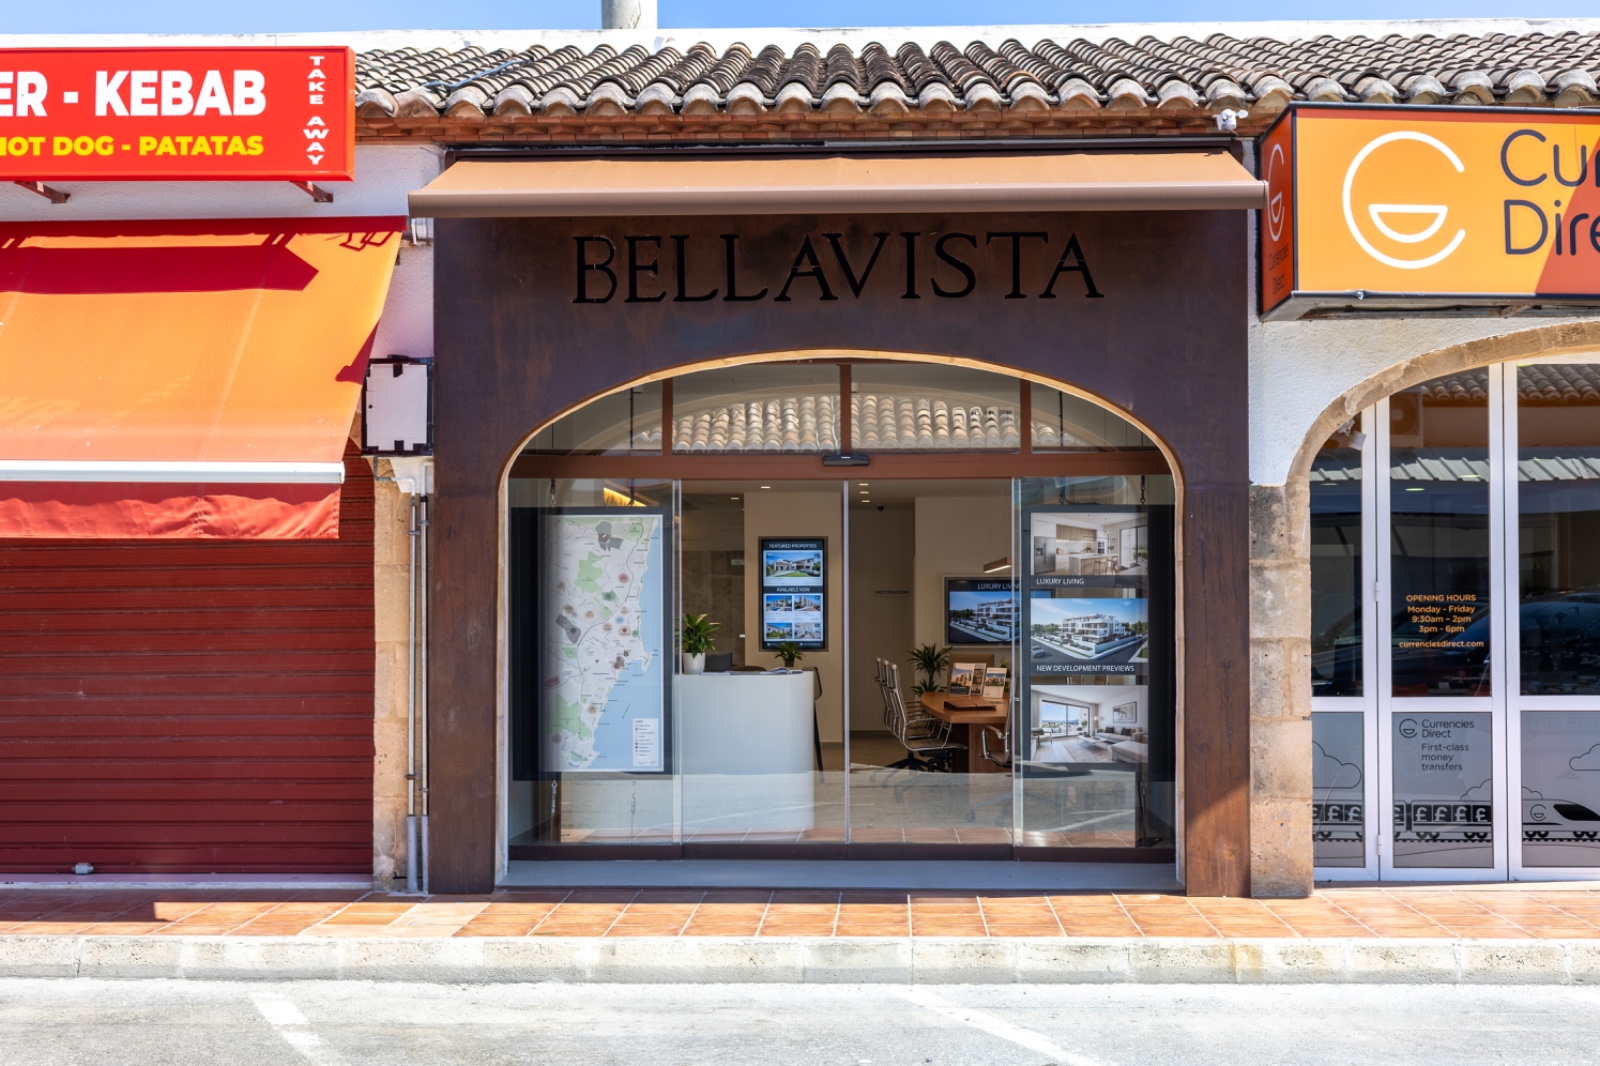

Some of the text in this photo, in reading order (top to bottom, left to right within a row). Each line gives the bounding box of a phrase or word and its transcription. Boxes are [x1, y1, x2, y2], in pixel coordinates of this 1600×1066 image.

[64, 92, 78, 103] -
[95, 70, 266, 116] KEBAB
[303, 56, 330, 166] TAKE AWAY
[53, 136, 114, 156] DOG
[139, 136, 264, 155] PATATAS
[1500, 129, 1600, 188] Cu
[1504, 199, 1600, 256] Dir
[572, 231, 1105, 304] BELLAVISTA
[1406, 594, 1476, 602] OPENING HOURS
[1407, 605, 1441, 614] Monday
[1448, 605, 1476, 614] Friday
[1412, 615, 1444, 623] 9:30am
[1452, 615, 1472, 624] 2pm
[1419, 625, 1438, 634] 3pm
[1445, 625, 1465, 634] 6pm
[1399, 640, 1485, 649] currenciesdirect.com
[1421, 719, 1475, 729] Currencies
[1421, 729, 1452, 739] Direct
[1421, 743, 1469, 751] First-class
[1421, 754, 1454, 763] money
[1421, 763, 1463, 771] transfers
